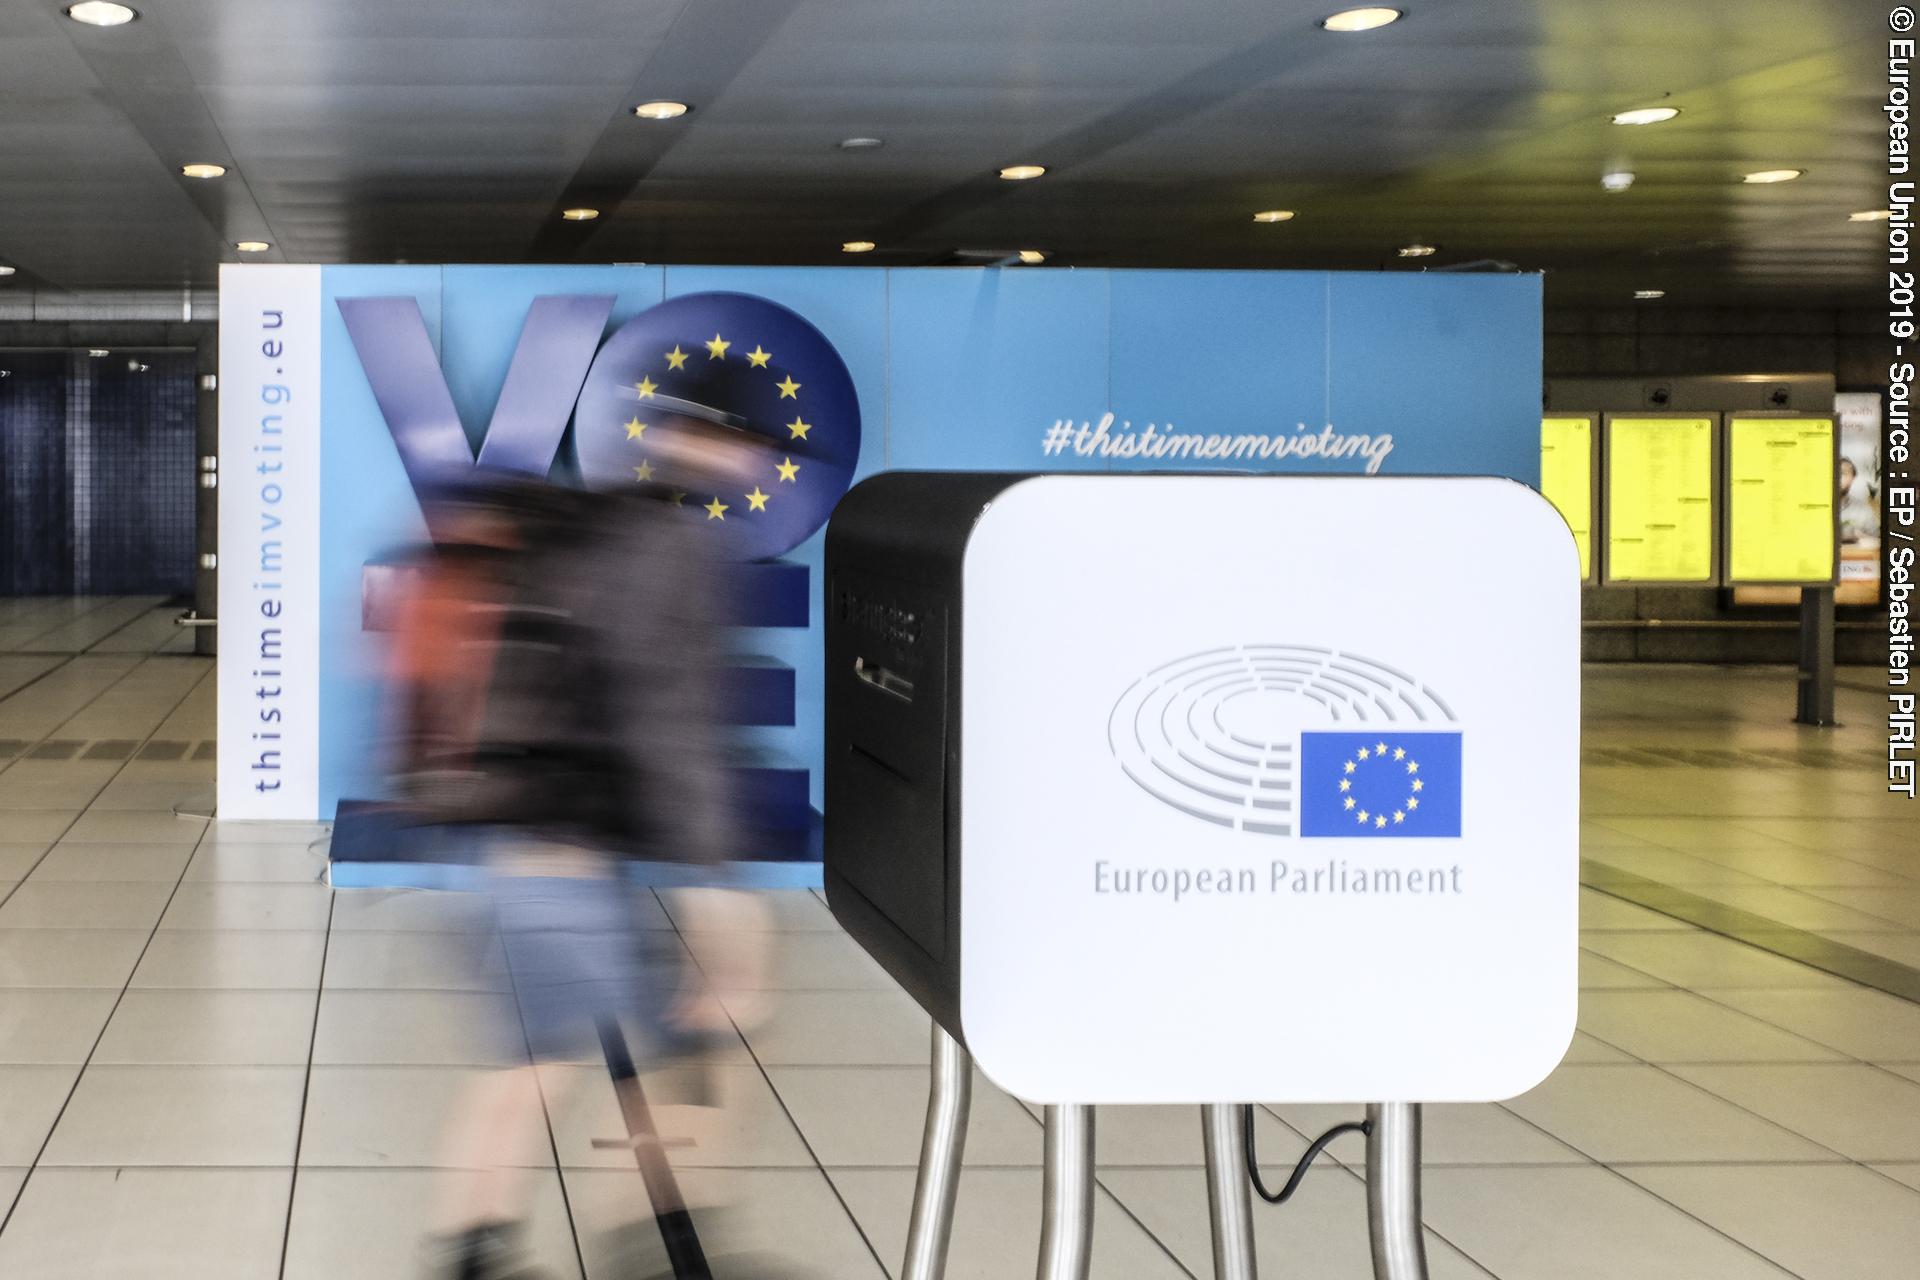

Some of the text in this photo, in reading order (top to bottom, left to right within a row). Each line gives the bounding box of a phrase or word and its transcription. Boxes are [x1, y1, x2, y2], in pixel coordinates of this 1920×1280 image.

[252, 309, 291, 793] thistimeimvoting.eu
[1095, 860, 1462, 901] European Parliament
